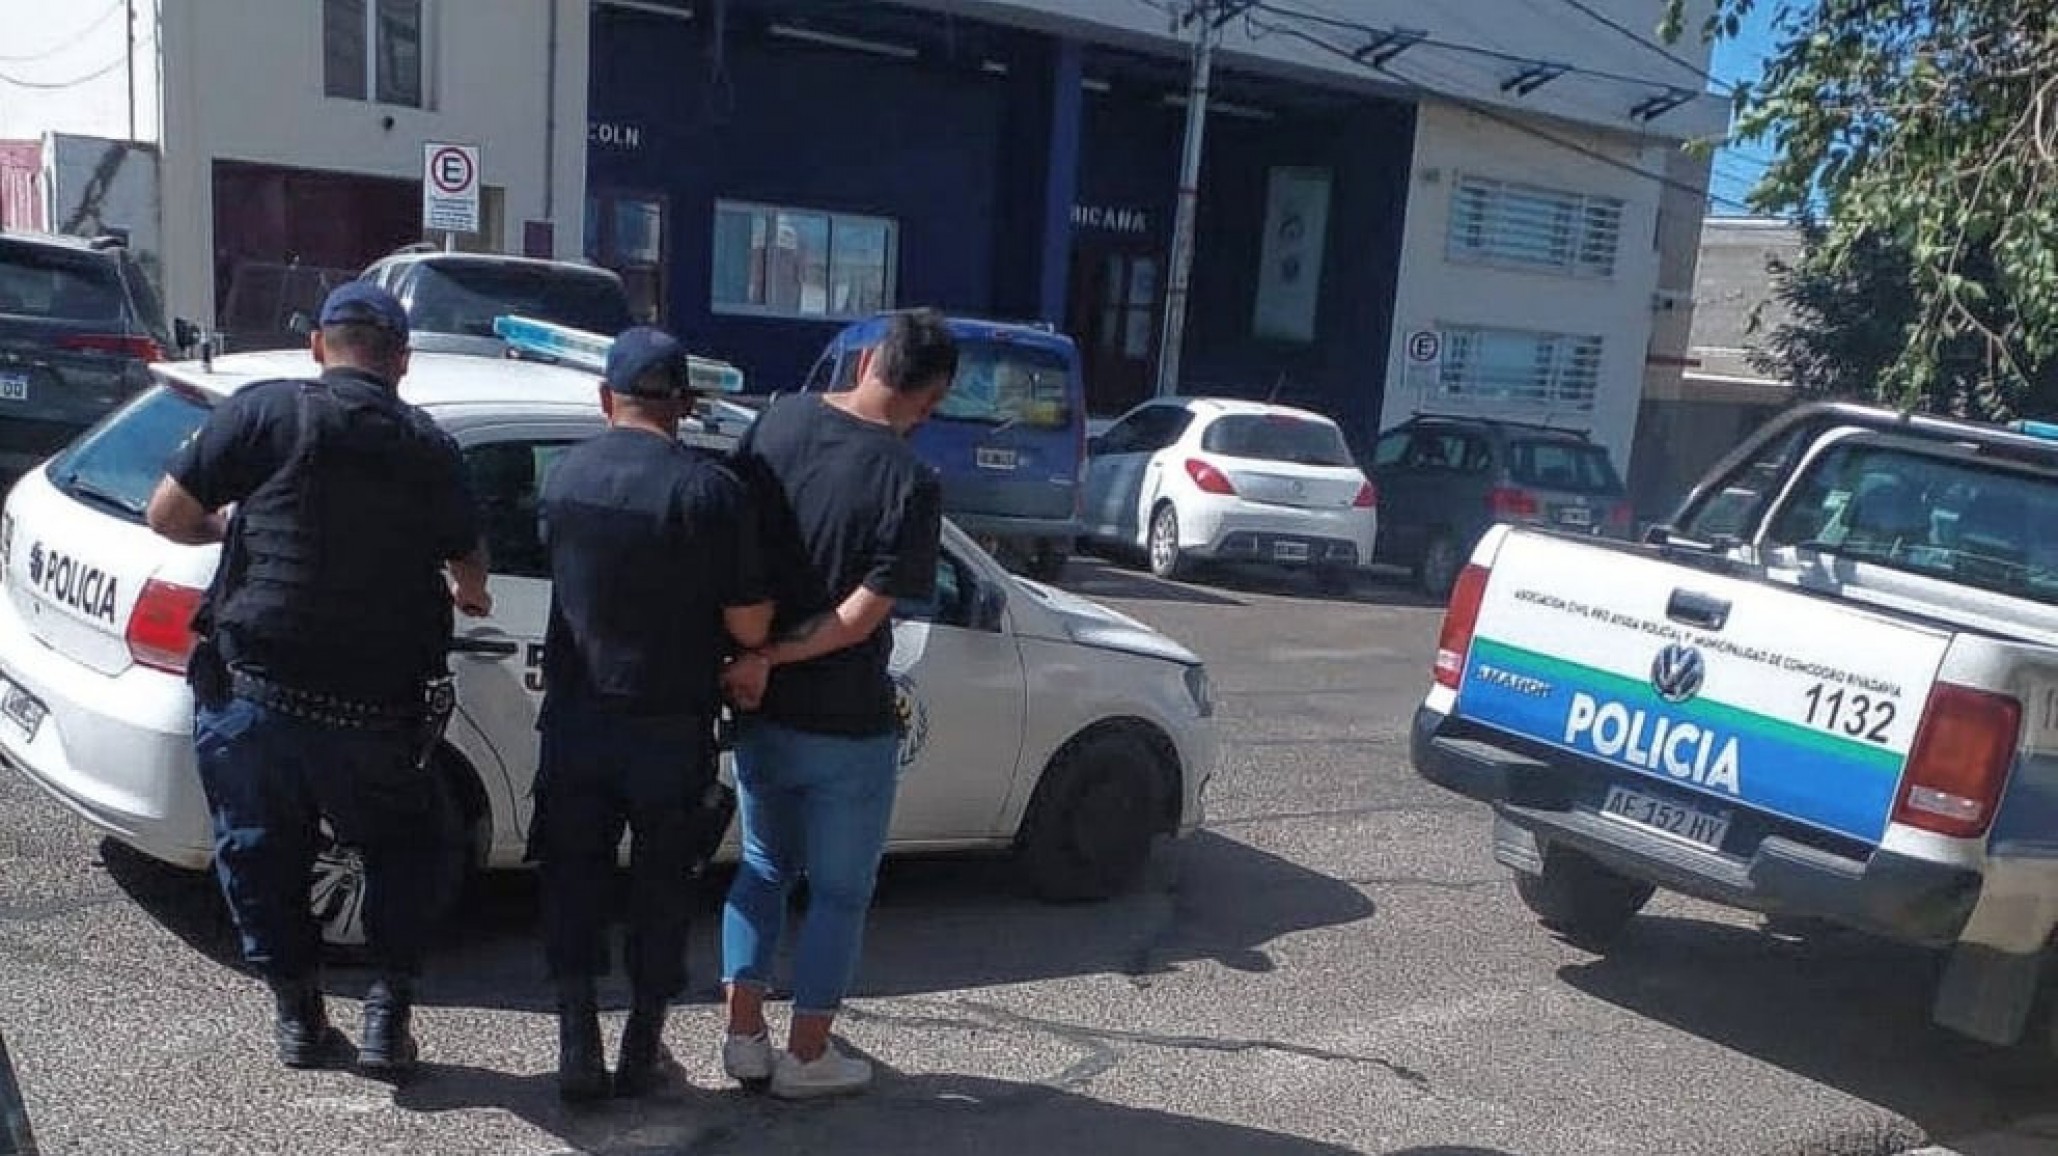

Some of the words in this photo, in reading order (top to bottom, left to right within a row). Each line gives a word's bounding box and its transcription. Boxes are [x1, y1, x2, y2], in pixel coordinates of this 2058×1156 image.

[442, 157, 463, 183] E
[44, 550, 117, 624] POLICIA
[1806, 682, 1896, 743] 1132
[1564, 692, 1741, 795] POLICIA
[1608, 791, 1637, 815] AE
[1645, 802, 1686, 832] 152
